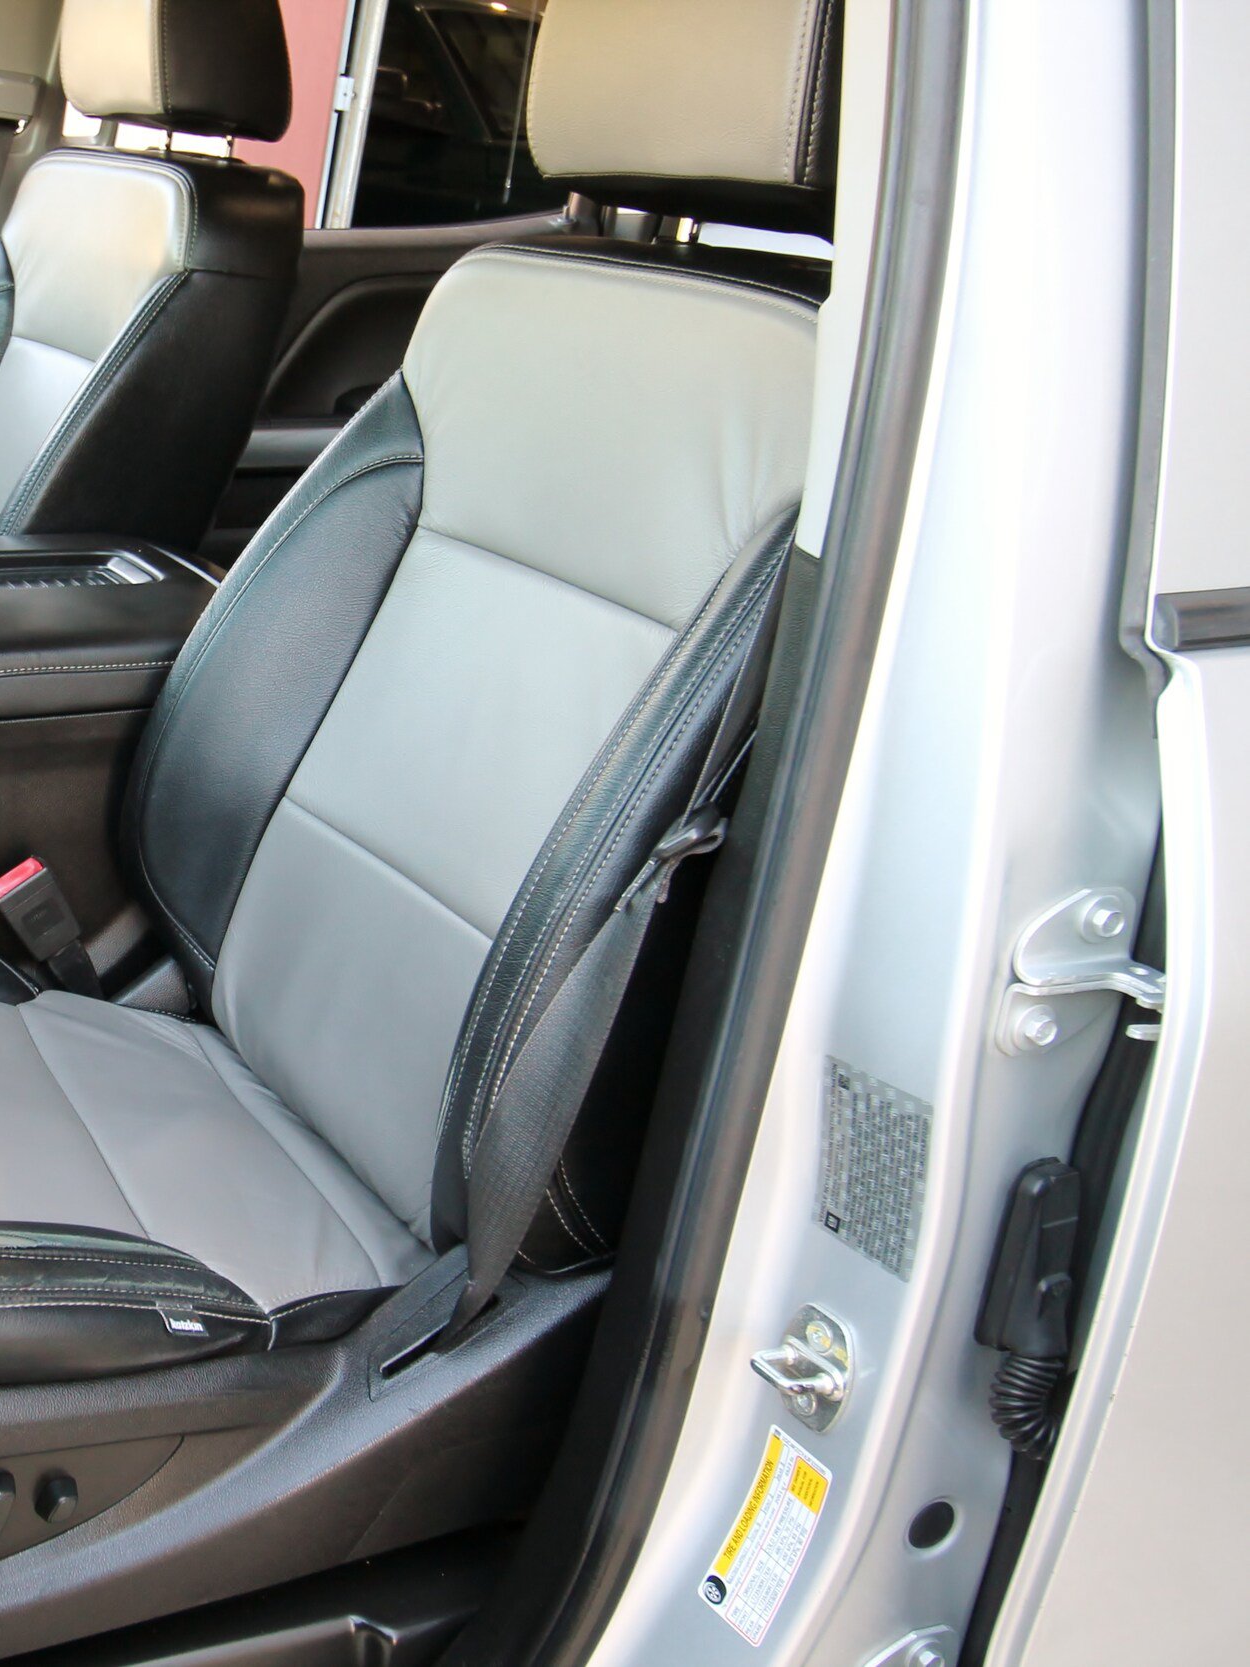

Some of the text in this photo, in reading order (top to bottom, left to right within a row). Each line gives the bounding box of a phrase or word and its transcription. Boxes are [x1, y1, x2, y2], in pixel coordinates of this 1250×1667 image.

[723, 1457, 773, 1560] TIRE AND LOADING INFORMATION
